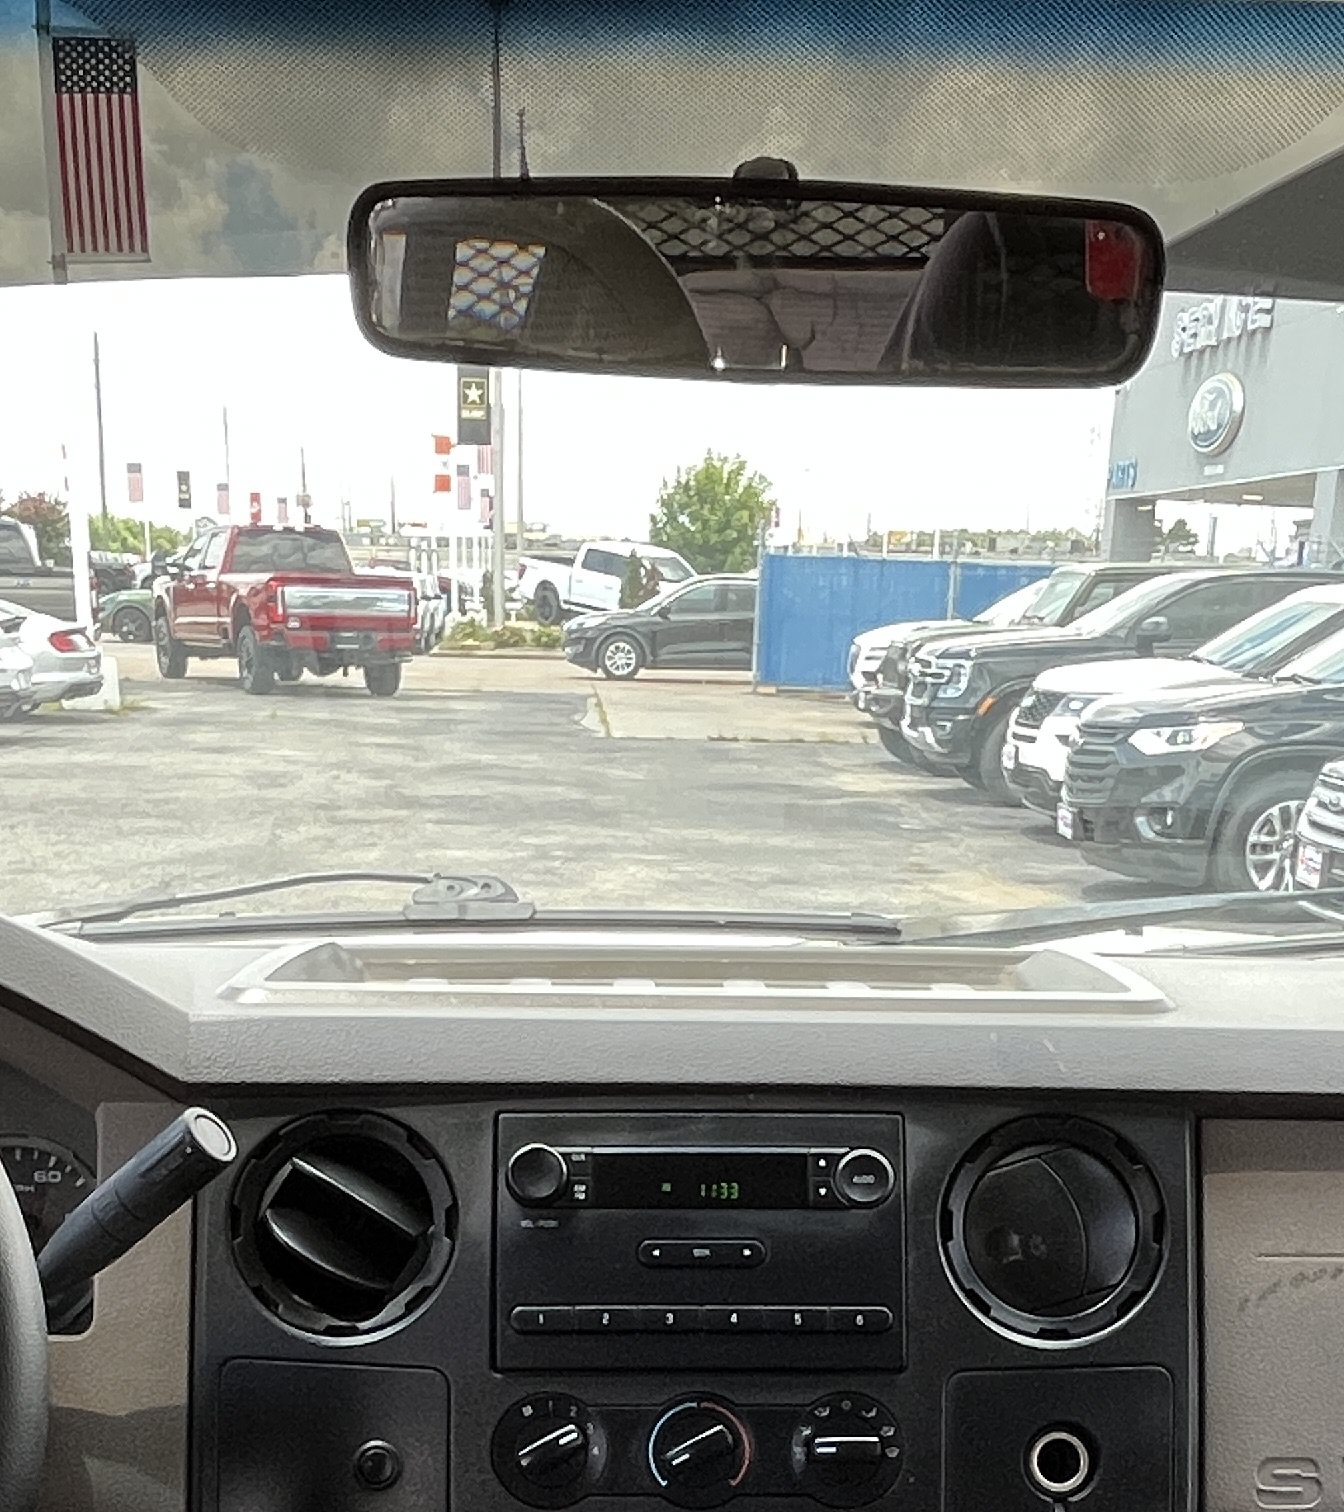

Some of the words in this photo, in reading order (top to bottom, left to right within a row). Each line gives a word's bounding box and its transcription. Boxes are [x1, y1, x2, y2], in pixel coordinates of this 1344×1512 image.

[33, 1170, 62, 1184] 60
[538, 1312, 545, 1325] 1
[602, 1312, 611, 1325] 2
[665, 1312, 674, 1325] 3
[730, 1312, 739, 1324] 4
